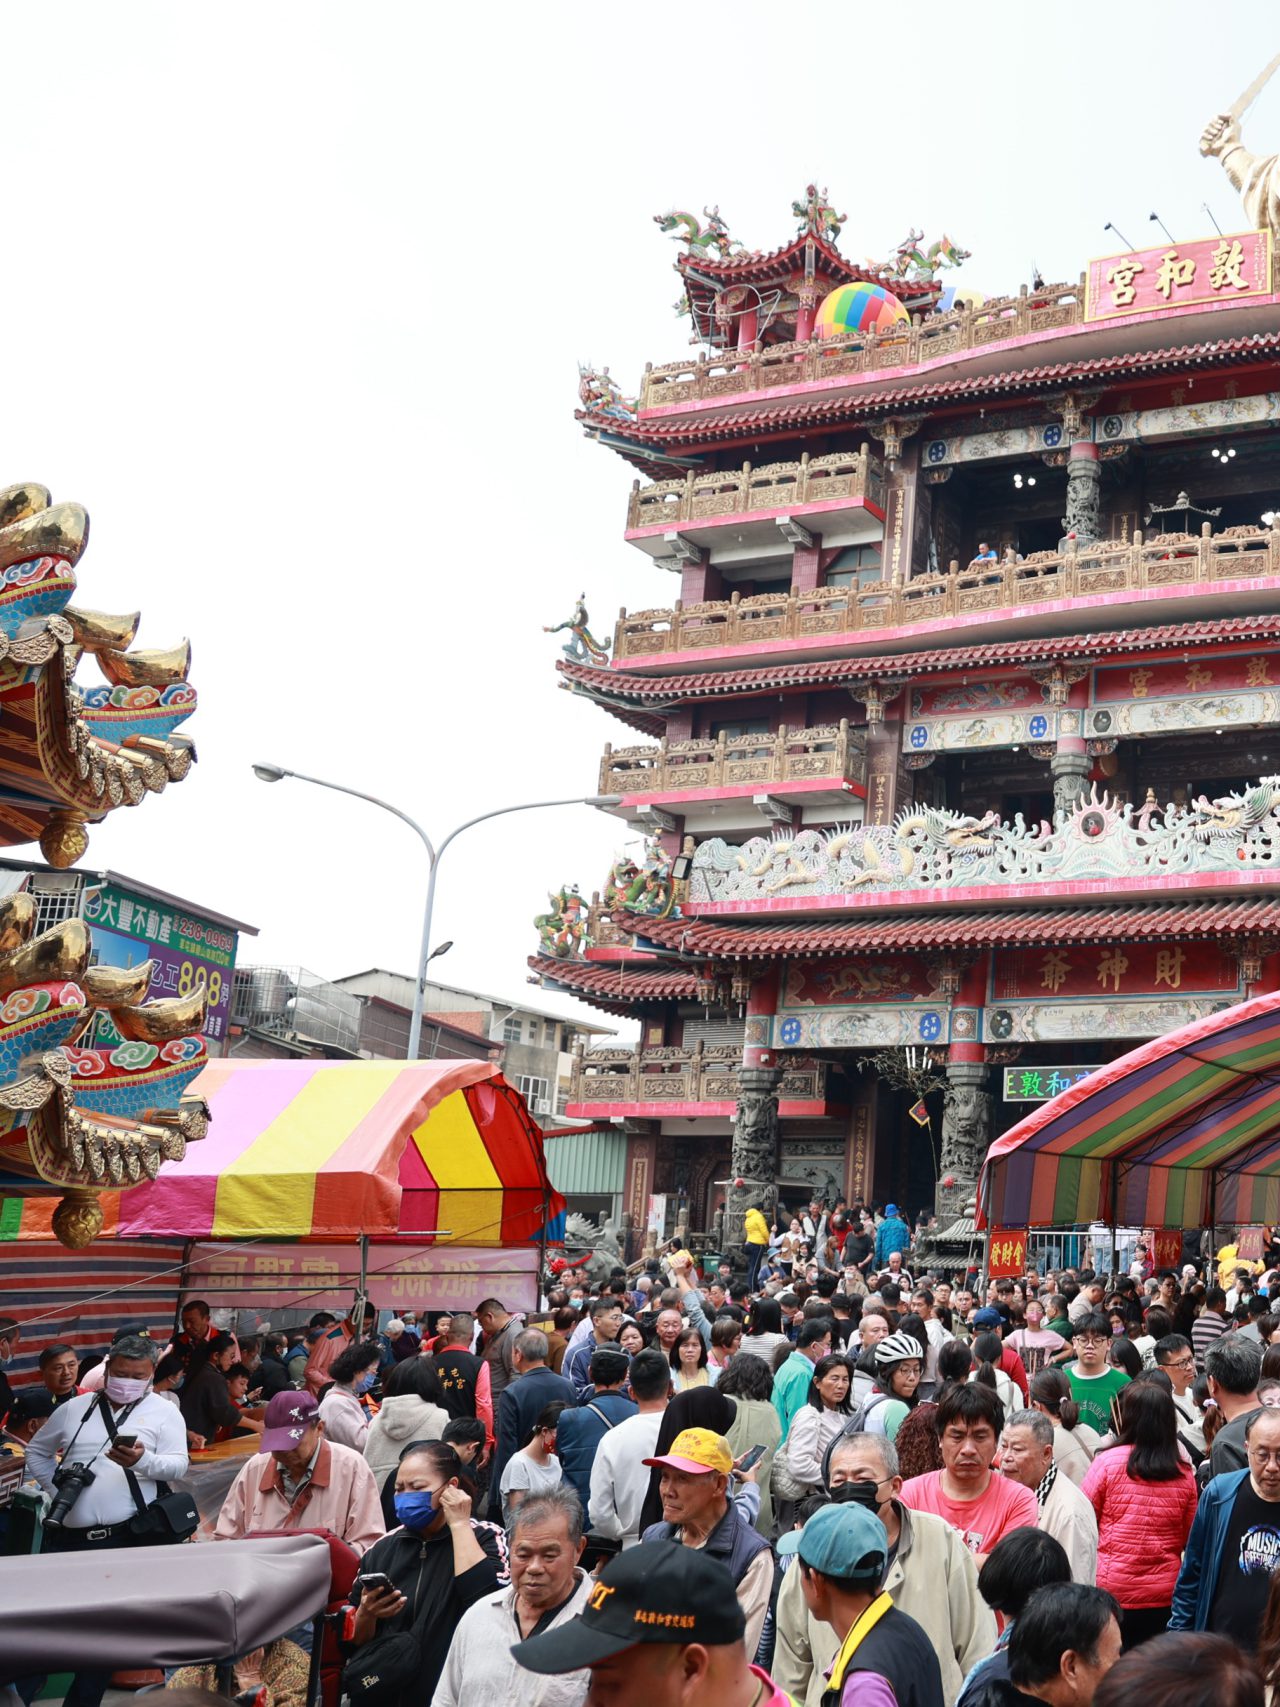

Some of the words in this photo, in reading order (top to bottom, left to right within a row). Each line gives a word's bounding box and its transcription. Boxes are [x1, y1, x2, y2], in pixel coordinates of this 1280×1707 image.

[1105, 239, 1250, 307] 敦和宮
[1128, 656, 1275, 698] 敦和宮
[100, 894, 173, 944] 大豐不動產
[178, 917, 234, 952] 238-0969
[1037, 946, 1187, 993] 財神爺
[1007, 1070, 1094, 1097] 敦和
[990, 1240, 1023, 1267] 發財金
